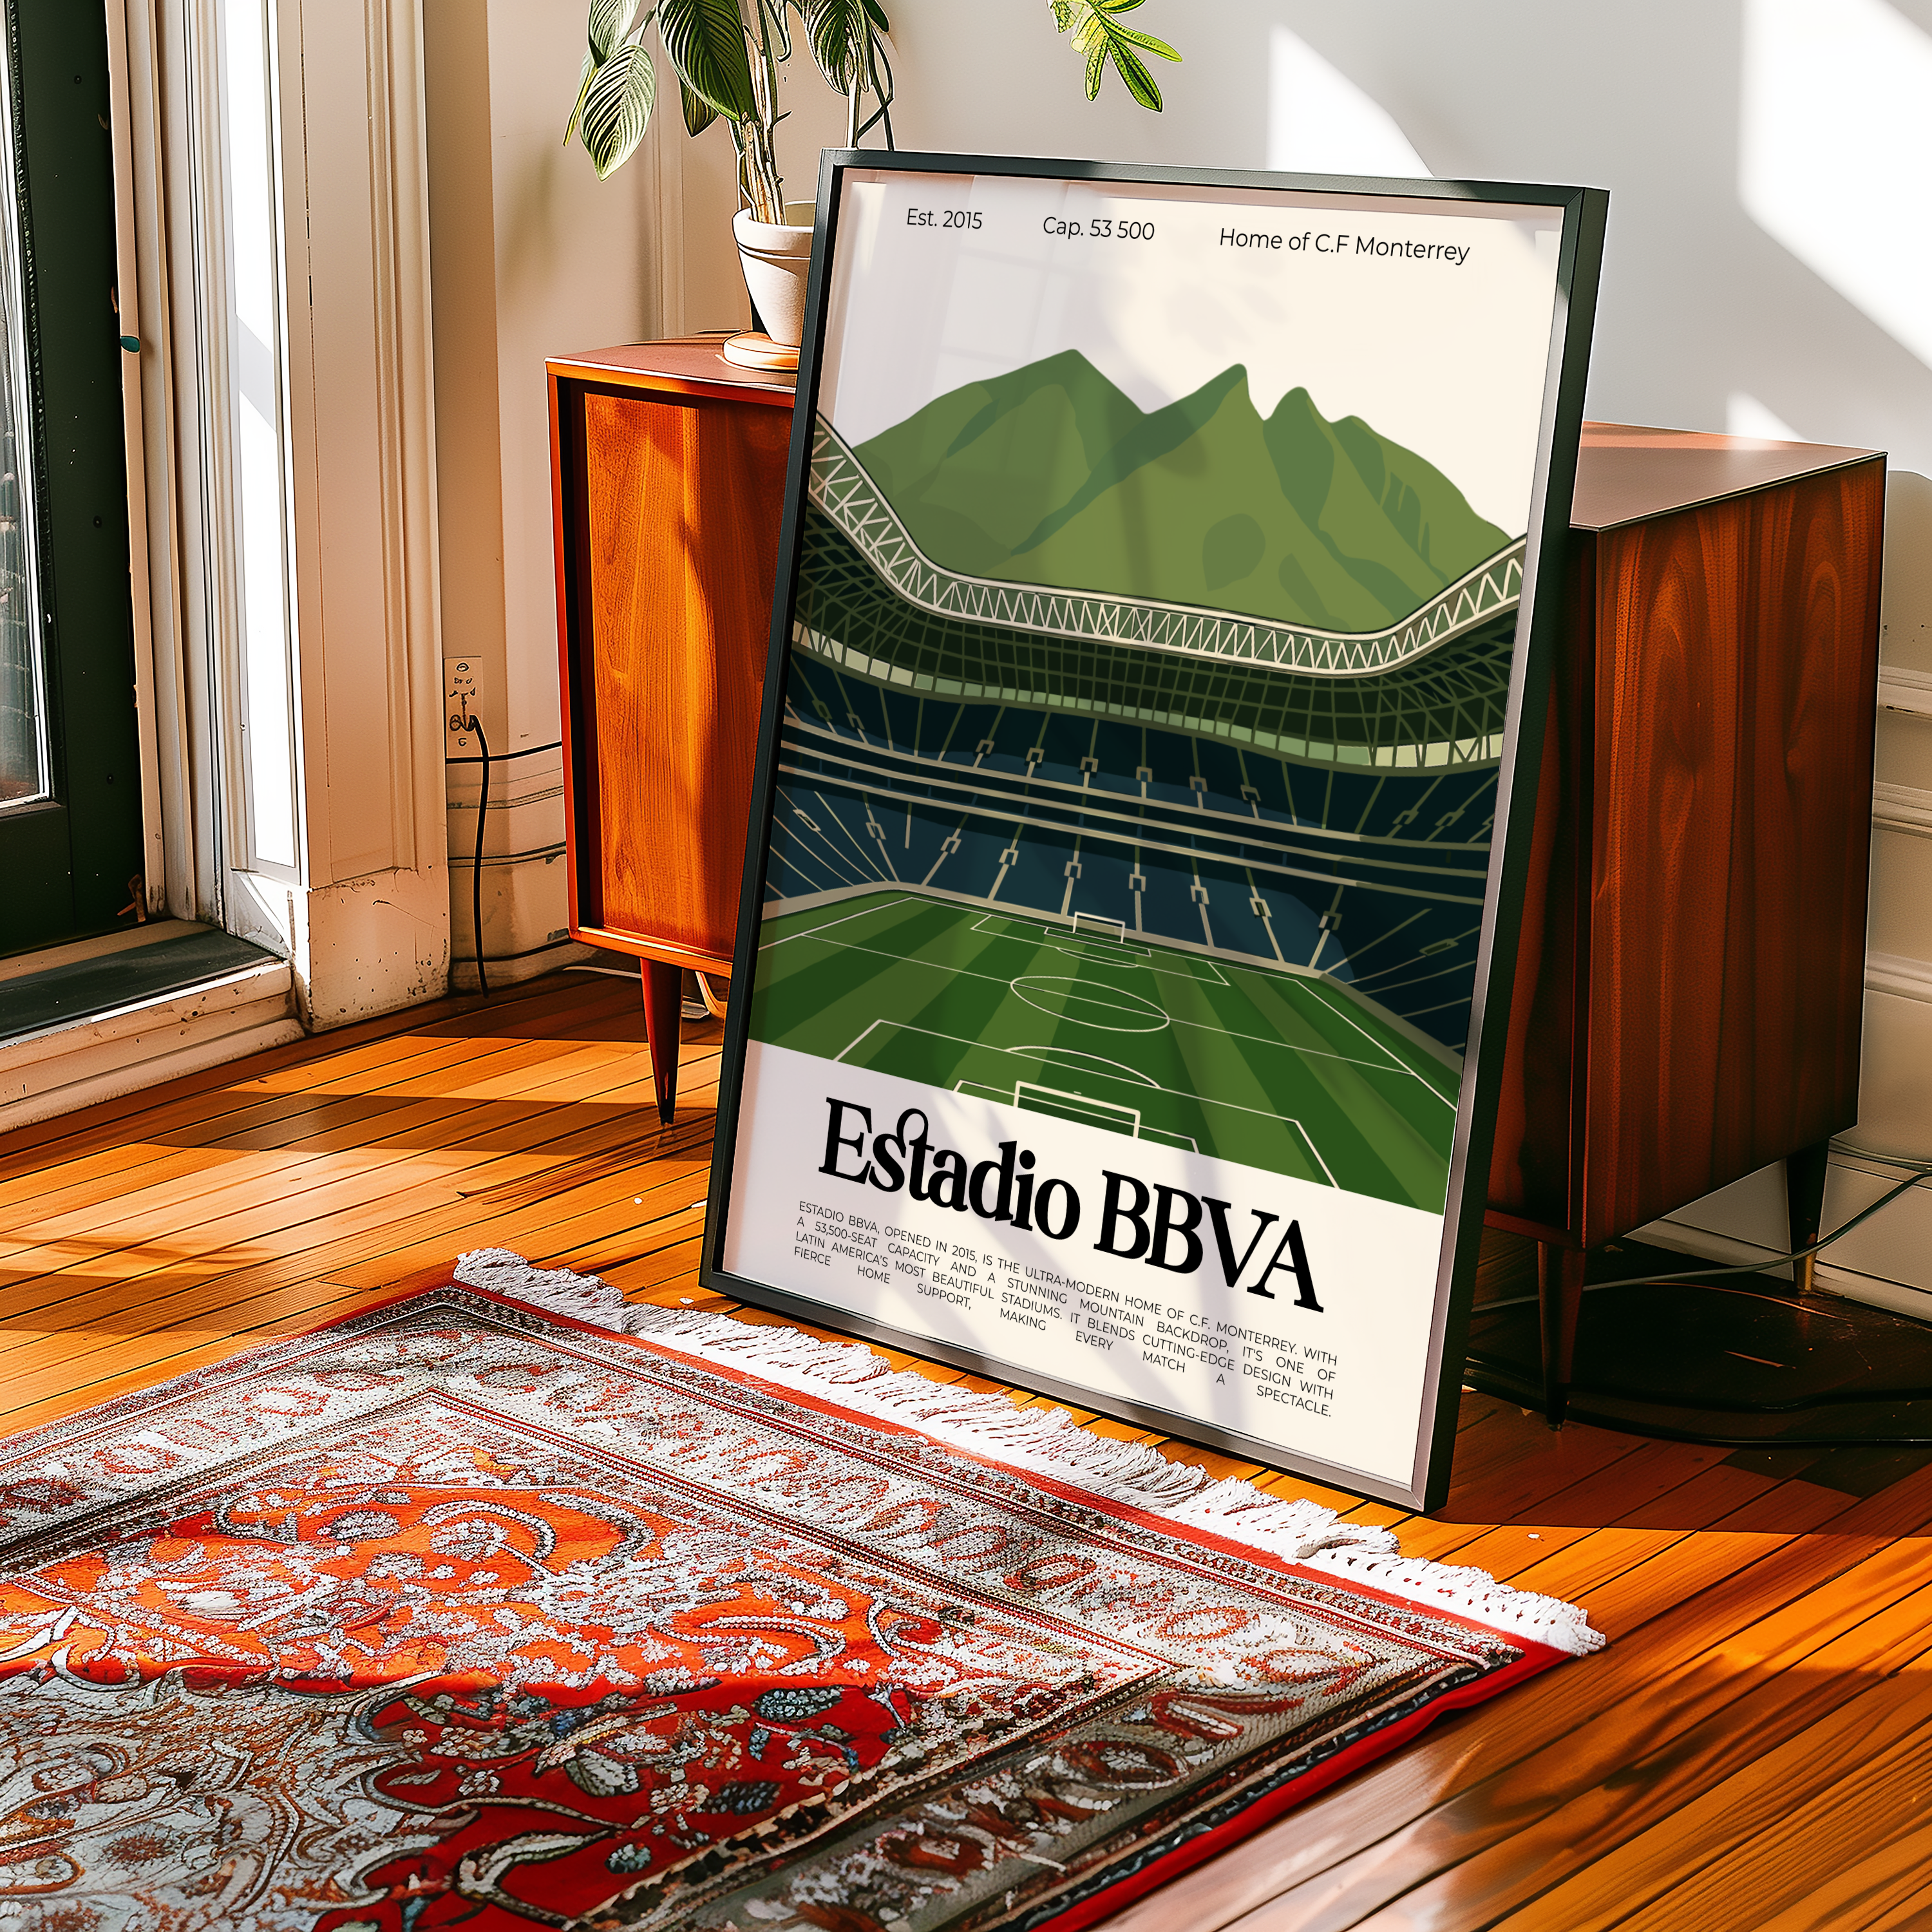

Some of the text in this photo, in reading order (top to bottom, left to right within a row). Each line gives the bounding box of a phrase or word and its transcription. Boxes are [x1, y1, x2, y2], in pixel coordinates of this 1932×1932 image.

[907, 208, 983, 230] Est. 2015
[1043, 216, 1155, 240] Cap. 53 500
[1220, 227, 1471, 266] Home of C.F Monterrey
[799, 1200, 1338, 1367] ESTADIO BBVA, OPENED IN 2015, IS THE ULTRA-MODERN HOME OF C.F. MONTERREY. WITH
[818, 1097, 1324, 1313] Estadio BBVA
[794, 1245, 1331, 1417] FIERCE HOME SUPPORT, MAKING EVERY MATCH A SPECTACLE.
[795, 1231, 825, 1249] LATIN
[895, 1260, 926, 1278] MOST
[932, 1271, 994, 1300] BEAUTIFUL
[1001, 1292, 1063, 1320] STADIUMS.
[1070, 1312, 1081, 1324] IT
[1087, 1317, 1135, 1341] BLENDS
[1142, 1334, 1235, 1371] CUTTING-EDGE
[1243, 1363, 1291, 1388] DESIGN
[1300, 1379, 1334, 1400] WITH
[797, 1216, 1336, 1382] A 53,500-SEAT CAPACITY AND A STUNNING MOUNTAIN BACKDROP, IT'S ONE OF
